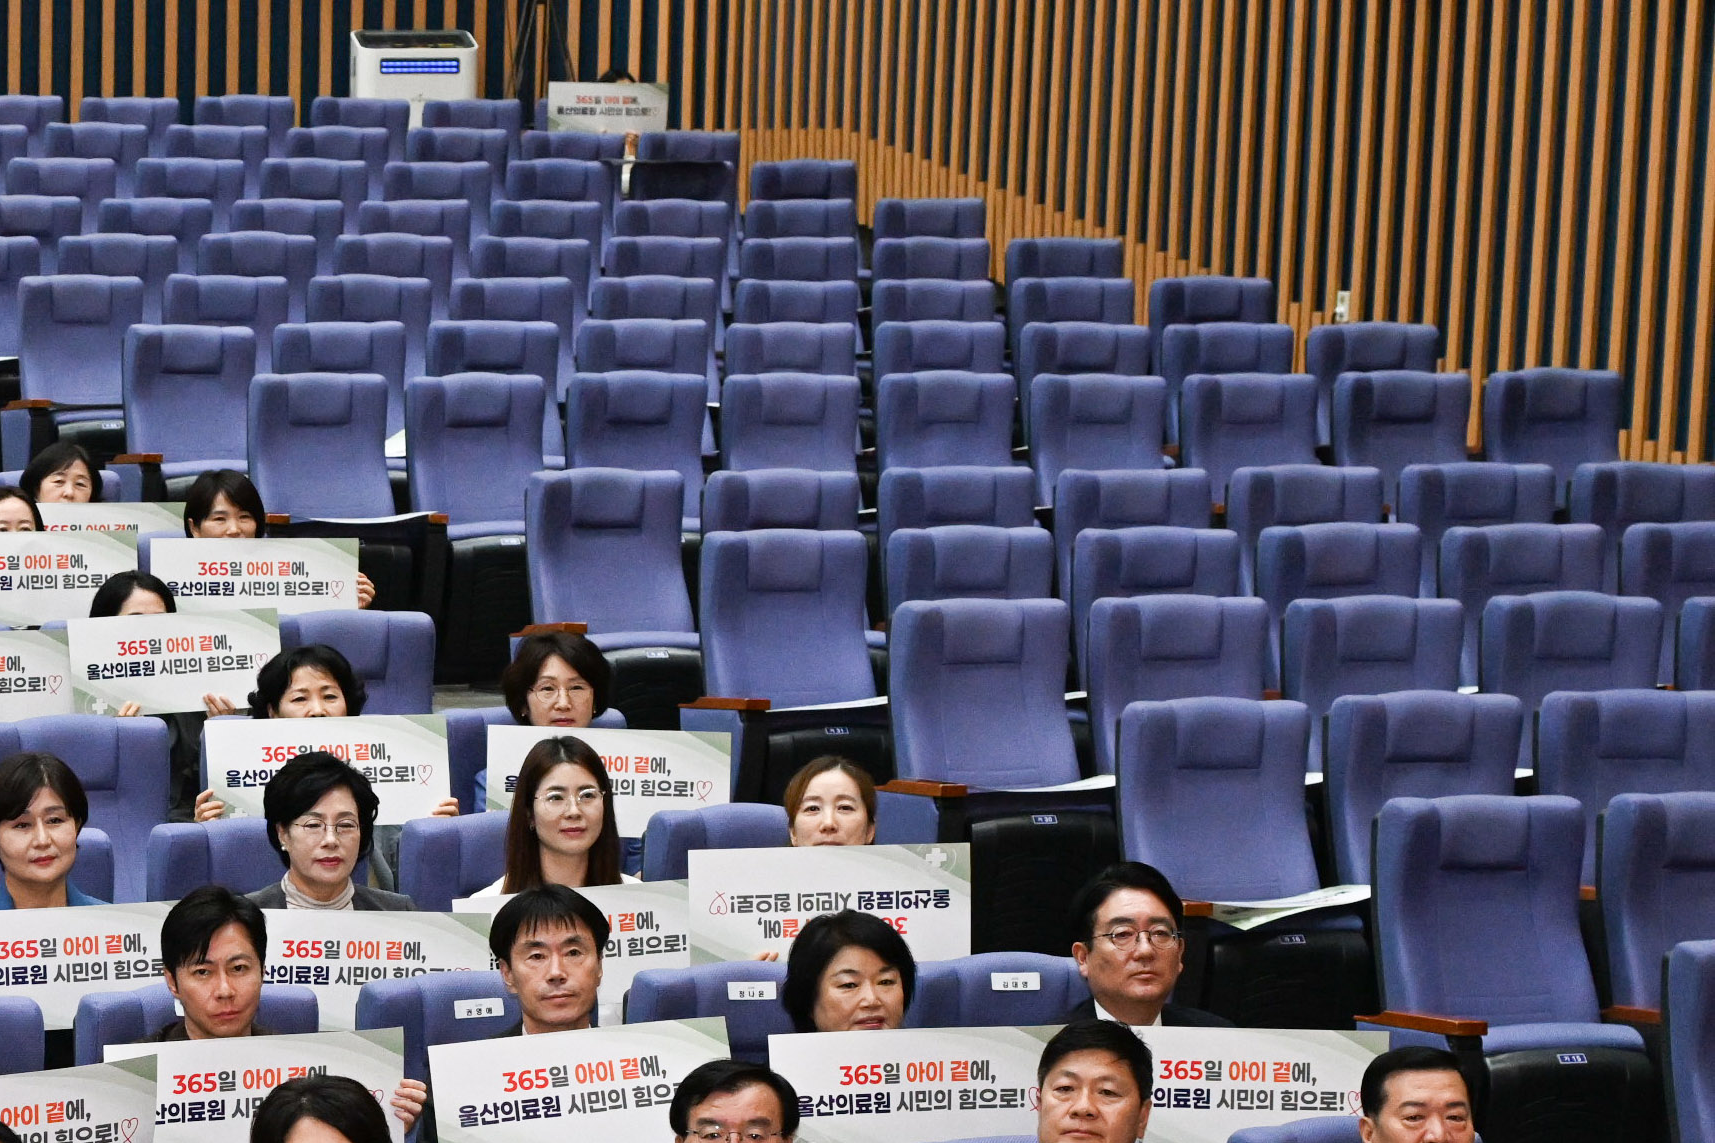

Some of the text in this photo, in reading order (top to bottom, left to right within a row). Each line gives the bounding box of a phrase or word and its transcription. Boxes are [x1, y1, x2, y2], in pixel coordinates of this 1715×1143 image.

[198, 561, 309, 578] 365일 아이 곁에,
[167, 580, 329, 597] 울산의료원 시민의 힘으로!
[117, 634, 232, 656] 365일 아이 곁에,
[87, 654, 254, 681] 울산의료원 시민의 힘으로!
[731, 889, 950, 913] 울산의료원 시민의 힘으로!
[839, 1060, 996, 1086] 365일 아이 곁에,
[797, 1088, 1025, 1118] 울산의료원 시민의 힘으로!
